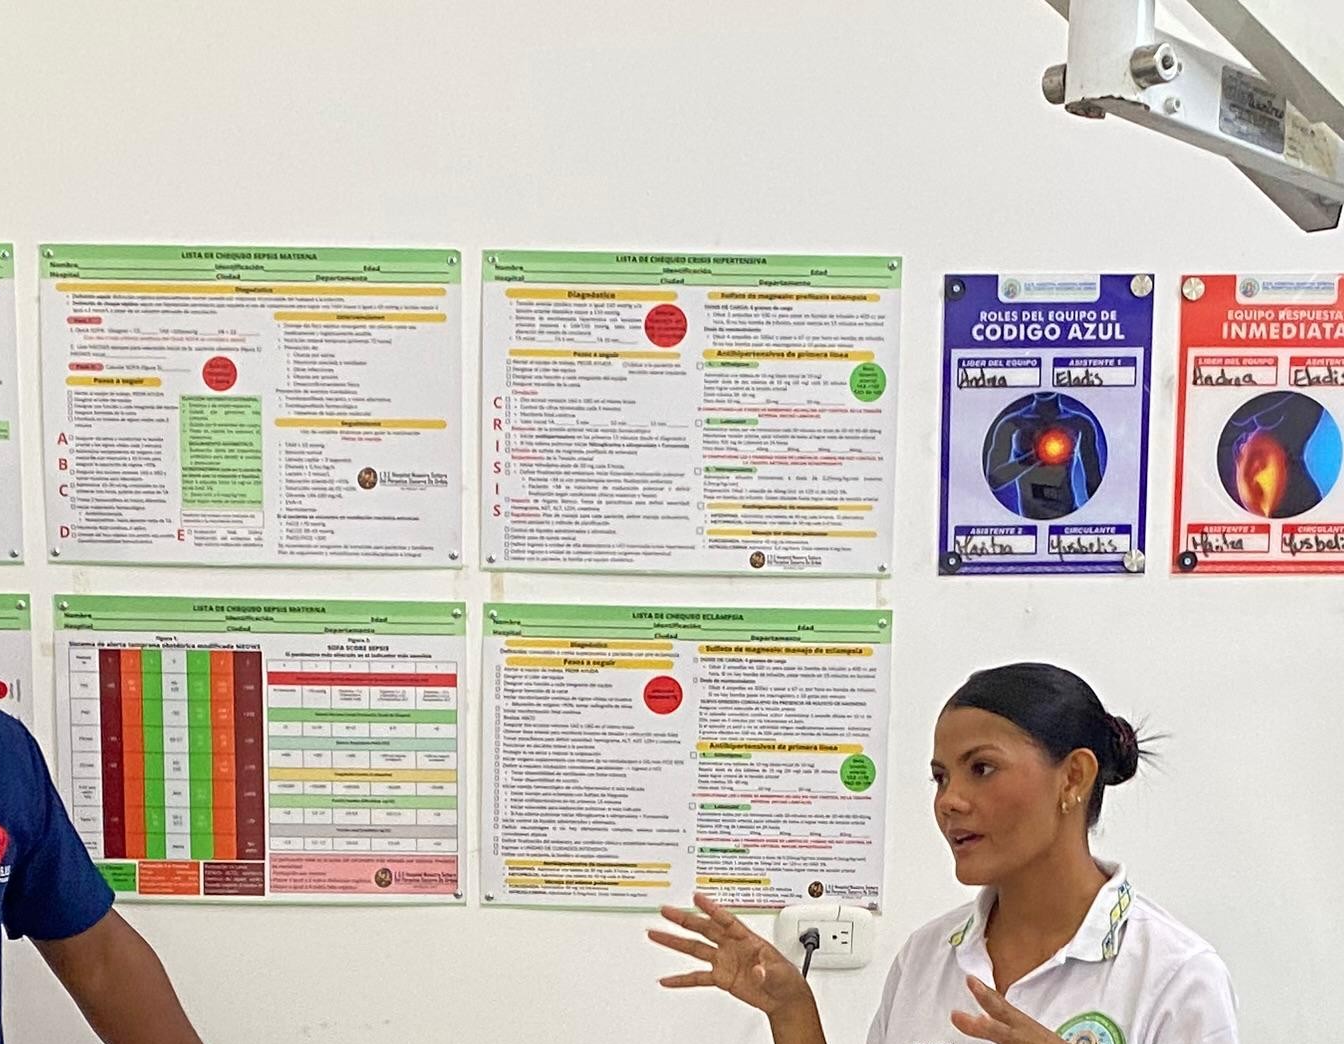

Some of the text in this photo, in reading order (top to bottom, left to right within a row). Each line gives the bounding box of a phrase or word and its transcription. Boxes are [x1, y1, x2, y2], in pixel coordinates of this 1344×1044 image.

[980, 310, 1116, 322] ROLES DEL EQUIPO DE
[1227, 310, 1344, 321] EQUIPO RESPUESTA
[972, 323, 1125, 341] CODIGO AZUL
[494, 397, 502, 409] C
[494, 419, 502, 430] R
[57, 432, 68, 445] A
[496, 441, 499, 452] I
[59, 458, 67, 470] B
[494, 462, 501, 473] S
[59, 484, 68, 497] C
[496, 483, 499, 495] I
[493, 505, 501, 517] S
[60, 526, 69, 538] D
[177, 529, 184, 541] E
